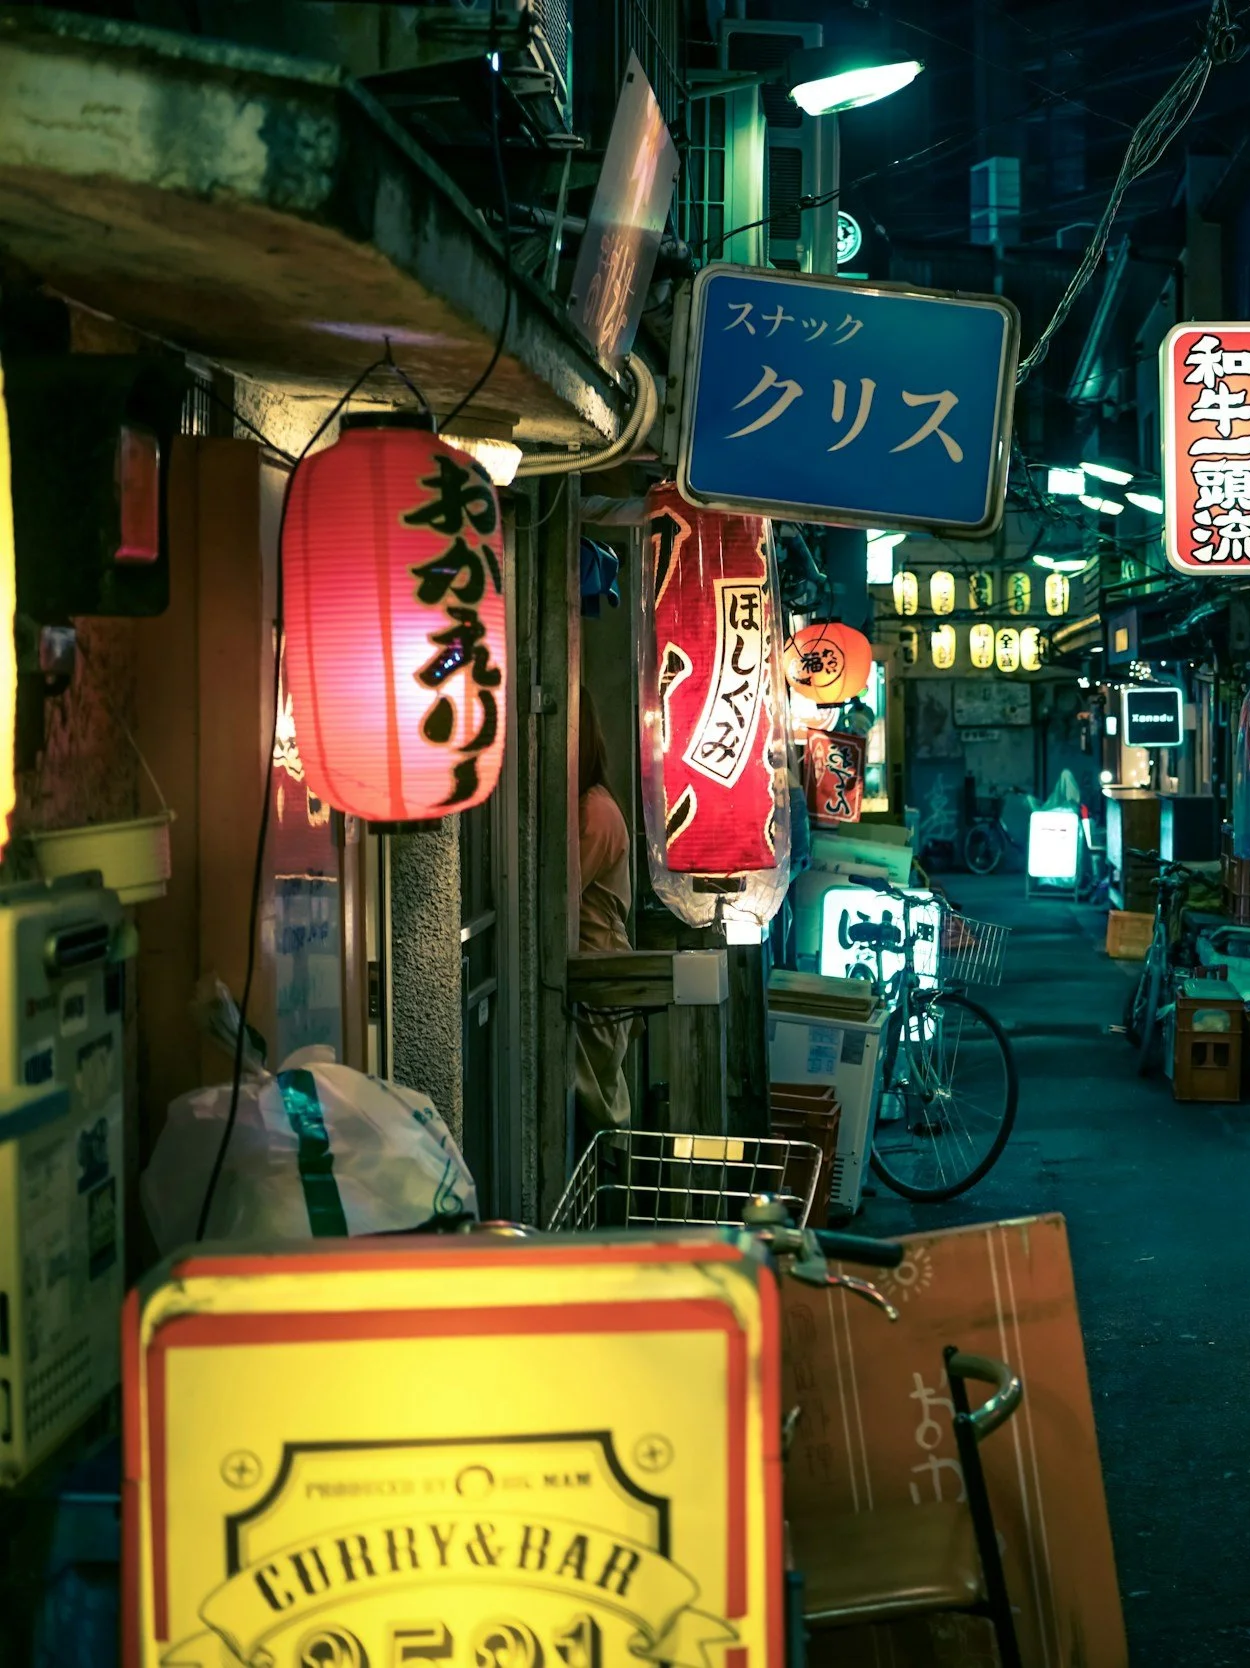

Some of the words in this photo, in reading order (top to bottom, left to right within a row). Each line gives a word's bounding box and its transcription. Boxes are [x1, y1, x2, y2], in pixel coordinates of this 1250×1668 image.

[722, 302, 864, 345] スナック
[723, 364, 964, 463] クリス
[701, 592, 760, 764] ほしぐみ
[800, 651, 824, 674] 福
[1131, 713, 1174, 723] Xanadu
[253, 1519, 642, 1612] CURRY&BAR
